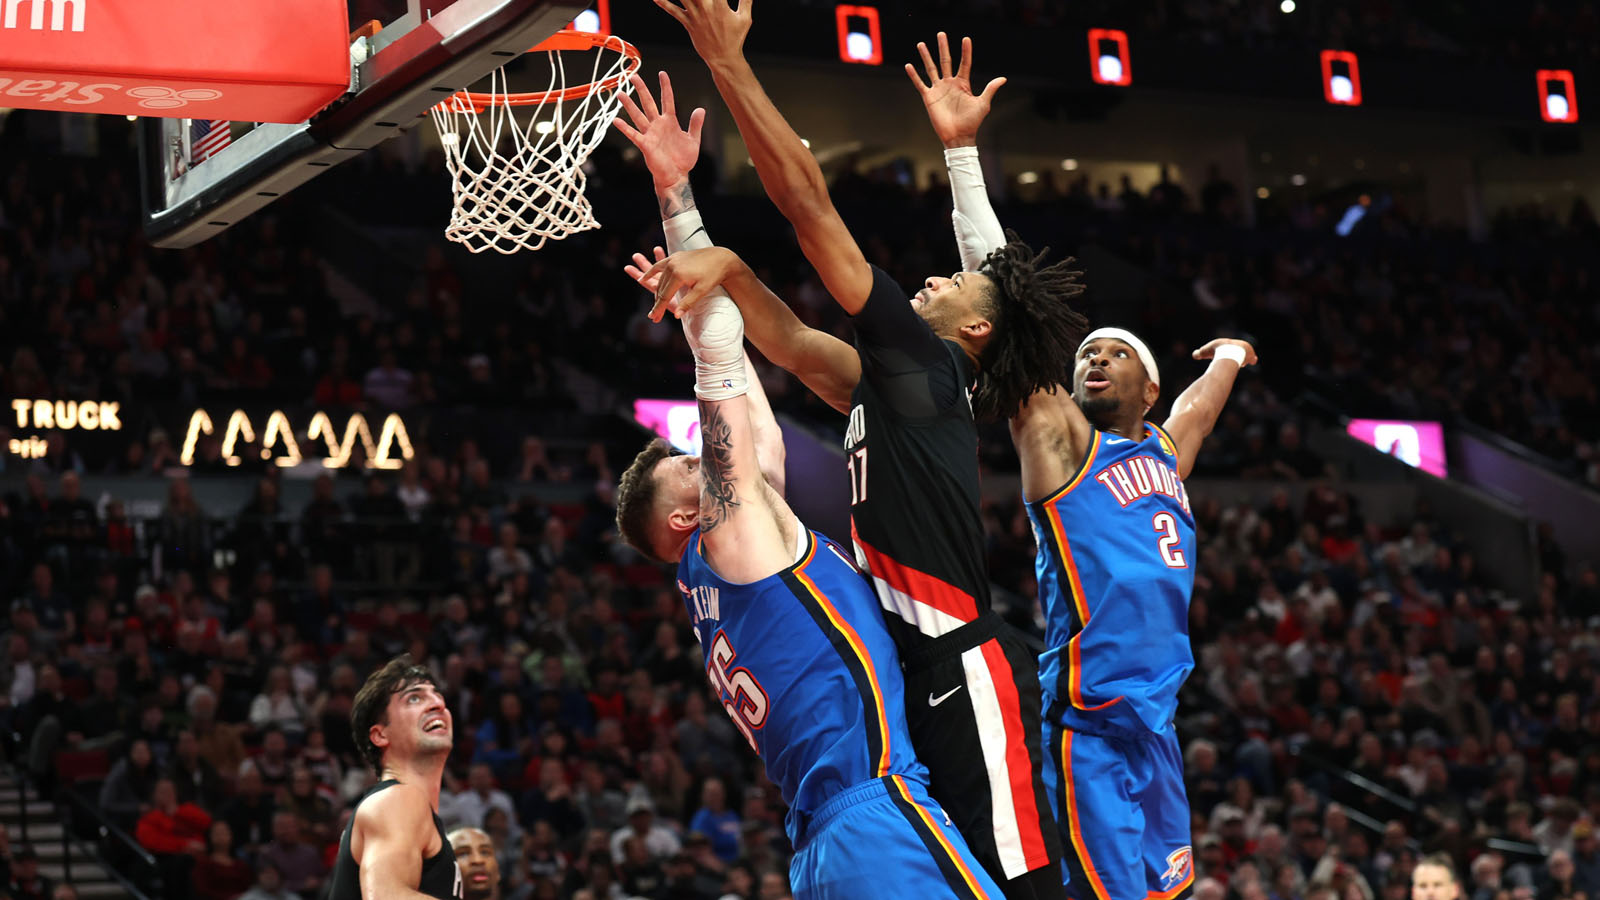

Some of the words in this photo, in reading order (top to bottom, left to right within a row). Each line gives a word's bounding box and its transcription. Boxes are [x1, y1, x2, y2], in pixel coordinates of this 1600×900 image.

[0, 0, 86, 32] rm
[11, 398, 123, 431] TRUCK
[847, 446, 868, 506] 17
[1152, 510, 1189, 569] 2
[690, 585, 720, 624] TEIN
